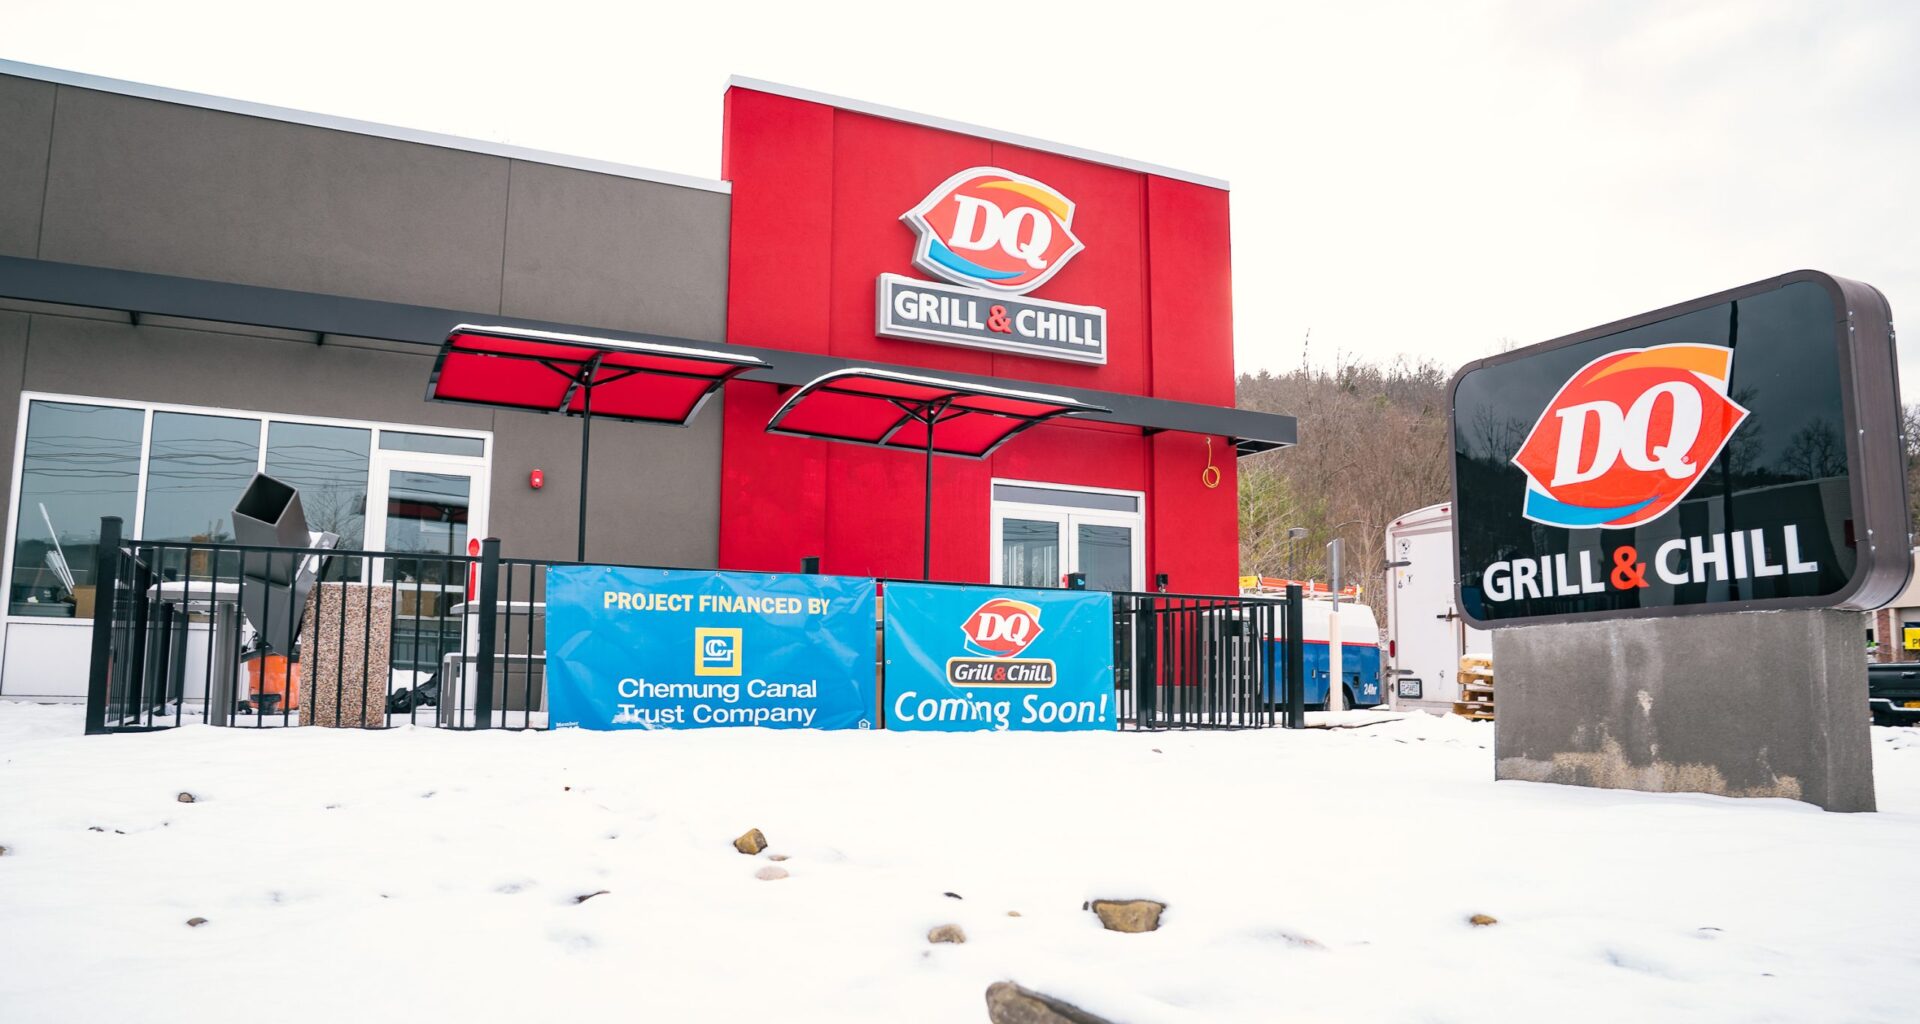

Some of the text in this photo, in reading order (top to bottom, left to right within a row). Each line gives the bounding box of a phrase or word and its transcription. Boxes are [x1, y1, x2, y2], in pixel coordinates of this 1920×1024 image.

[948, 193, 1053, 269] DQ
[894, 290, 1100, 347] GRILL & CHILL
[1550, 380, 1703, 488] DQ
[1482, 524, 1818, 602] GRILL & CHILL
[604, 591, 831, 616] PROJECT FINANCED BY
[975, 612, 1031, 647] DQ
[617, 678, 817, 703] Chemung Canal
[617, 704, 817, 726] Trust Company
[894, 691, 1108, 730] Coming Soon!
